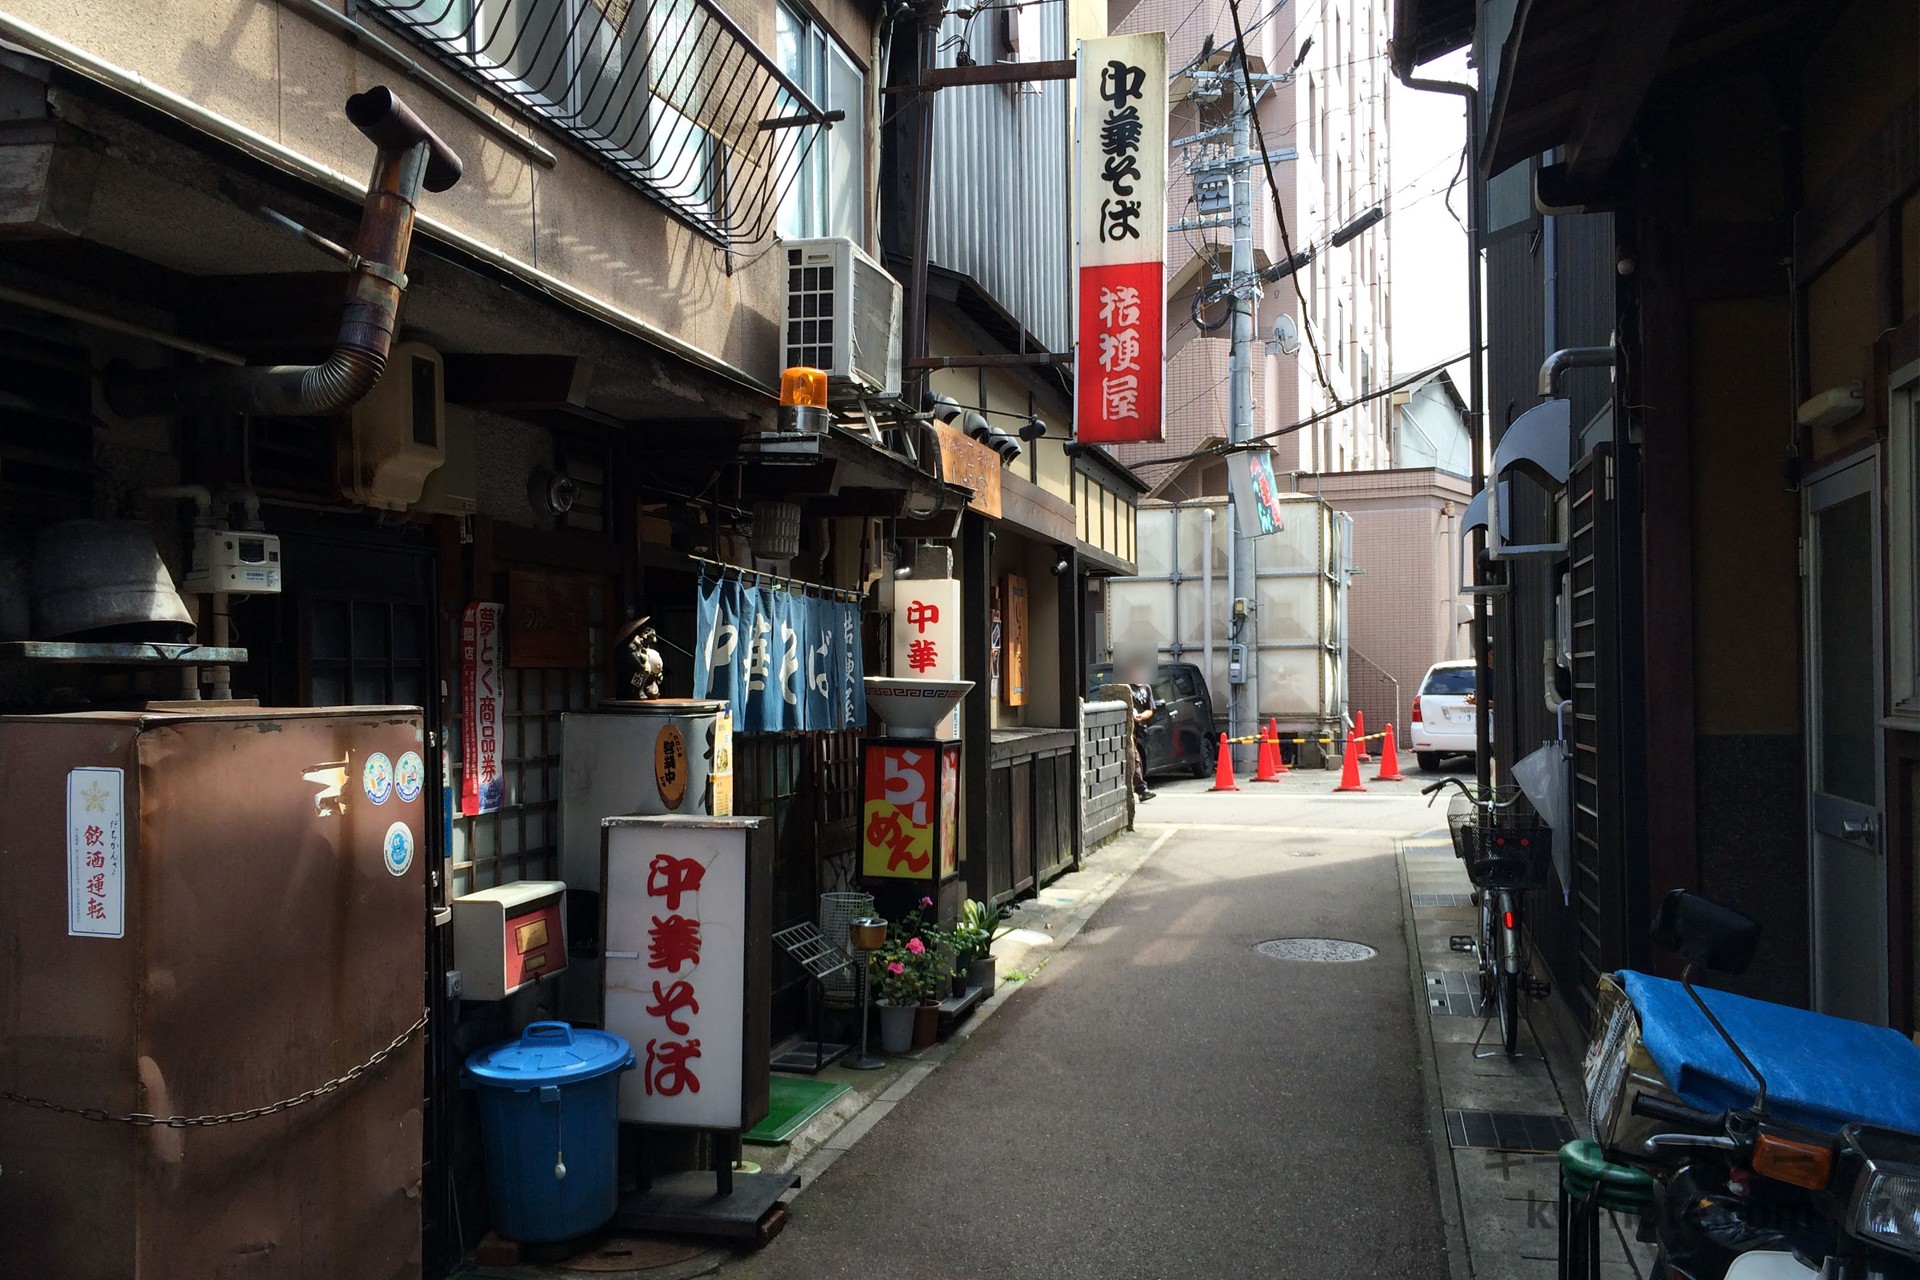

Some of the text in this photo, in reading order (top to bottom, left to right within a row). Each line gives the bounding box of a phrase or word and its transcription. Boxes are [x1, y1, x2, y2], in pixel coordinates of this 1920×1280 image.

[1099, 60, 1145, 243] 中華そば
[1099, 286, 1141, 422] 桔梗屋
[479, 606, 496, 784] 夢とく商品券
[705, 603, 832, 705] 中華そば
[907, 600, 939, 673] 中華
[84, 824, 108, 921] 飲酒運転
[866, 749, 931, 873] らーめん
[645, 853, 706, 1097] 中華そば
